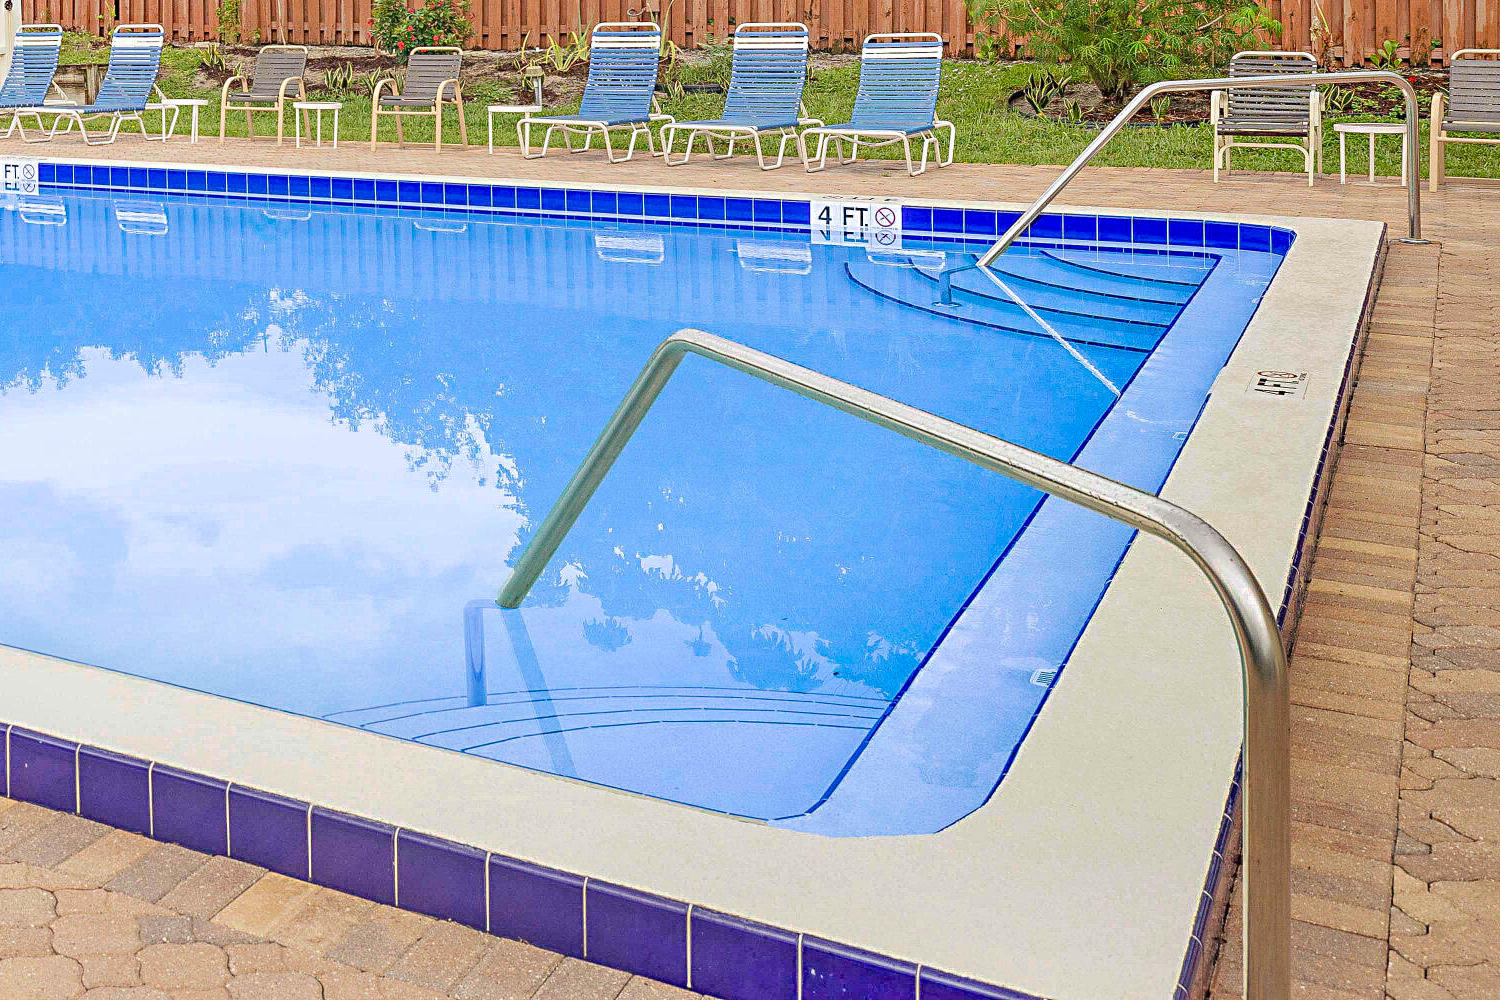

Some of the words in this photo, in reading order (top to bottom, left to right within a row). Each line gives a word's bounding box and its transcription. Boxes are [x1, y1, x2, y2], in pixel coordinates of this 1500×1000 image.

[4, 164, 20, 179] FT.
[818, 206, 832, 225] 4
[843, 206, 869, 227] FT.
